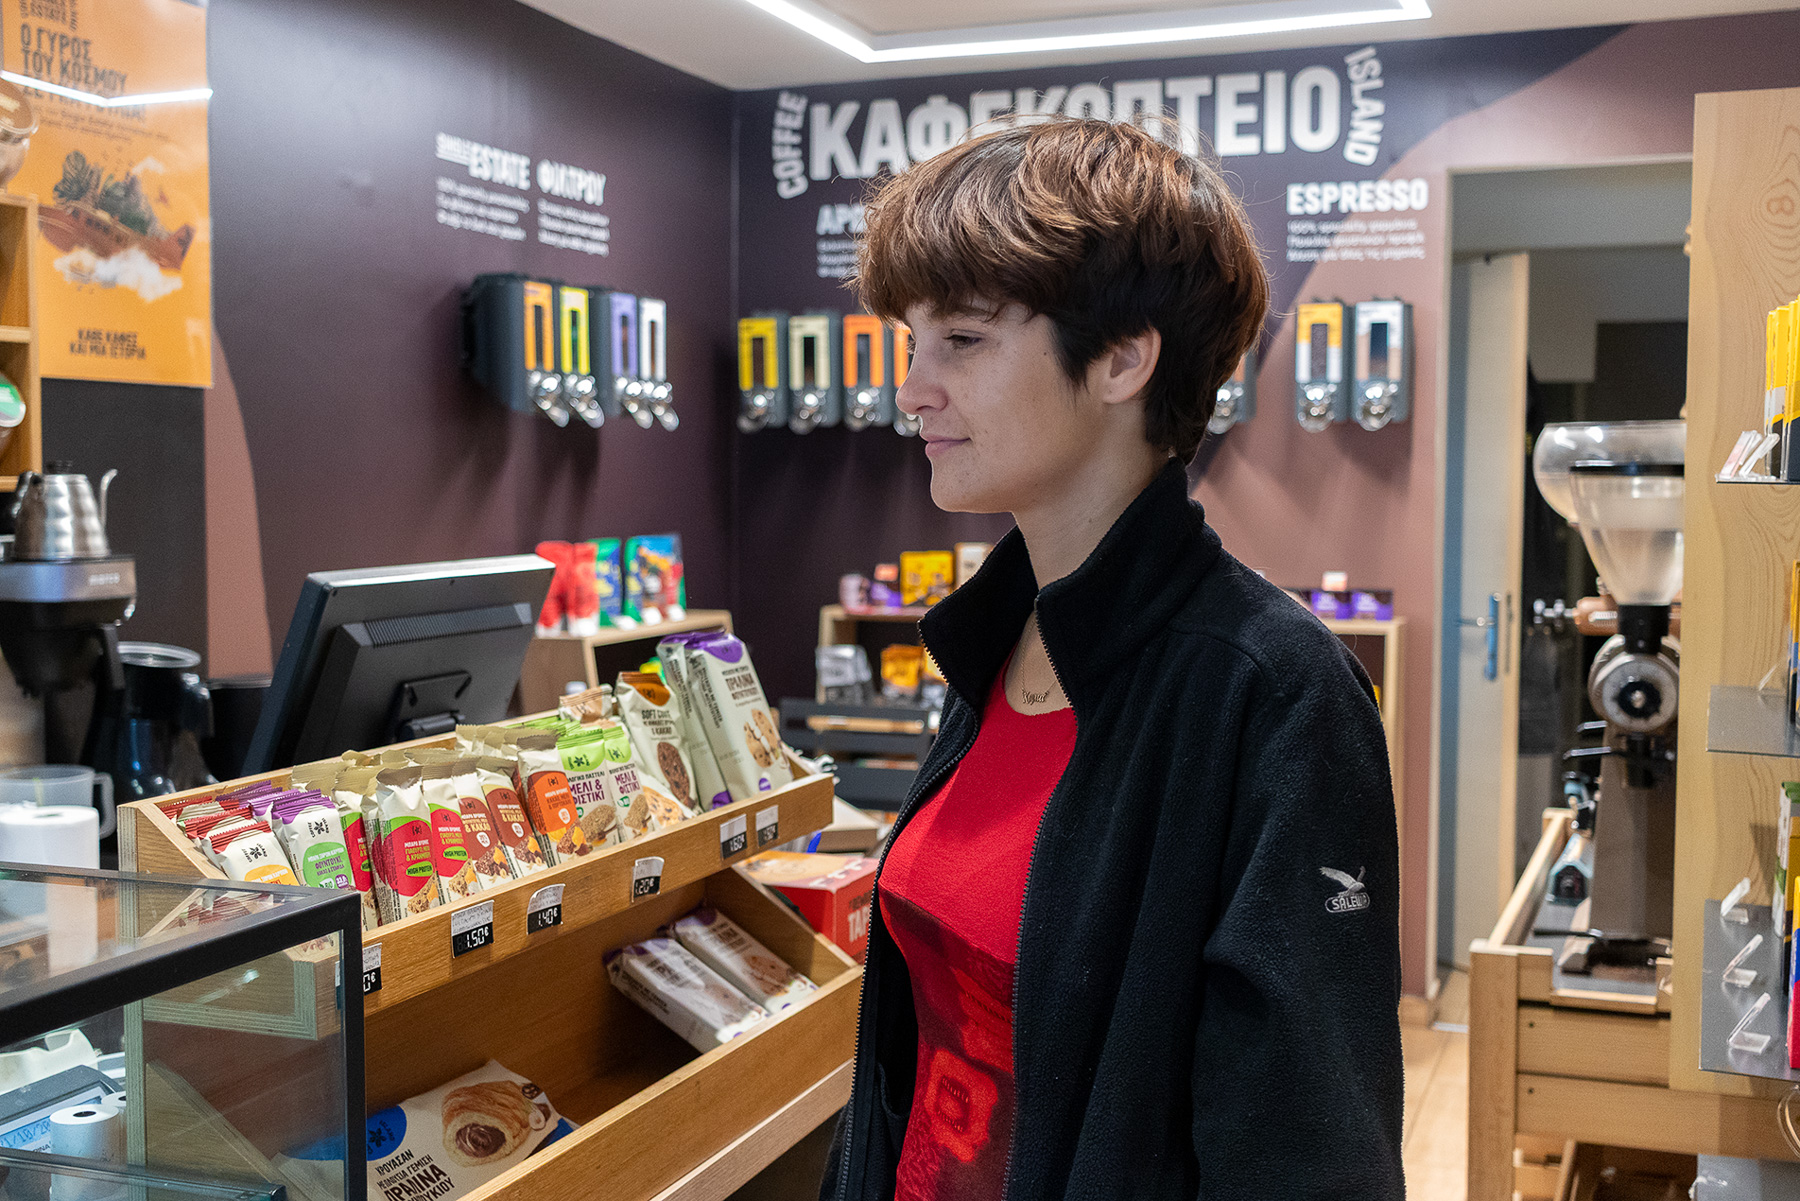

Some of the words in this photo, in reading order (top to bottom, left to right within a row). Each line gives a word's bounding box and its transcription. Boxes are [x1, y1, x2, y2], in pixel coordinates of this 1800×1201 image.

[1343, 45, 1384, 167] ISLAND
[772, 90, 809, 199] COFFEE
[469, 142, 531, 191] ESTATE
[1286, 178, 1429, 215] ESPRESSO
[570, 781, 593, 796] ΜΕΛΙ
[595, 778, 603, 791] &
[1331, 894, 1367, 911] SALE
[538, 907, 559, 927] 1.40€
[466, 926, 489, 948] 1.50€
[375, 1149, 415, 1177] ΧΡΟΥΑΣΑΝ
[406, 1154, 434, 1175] ΓΕΜΙΣΗ
